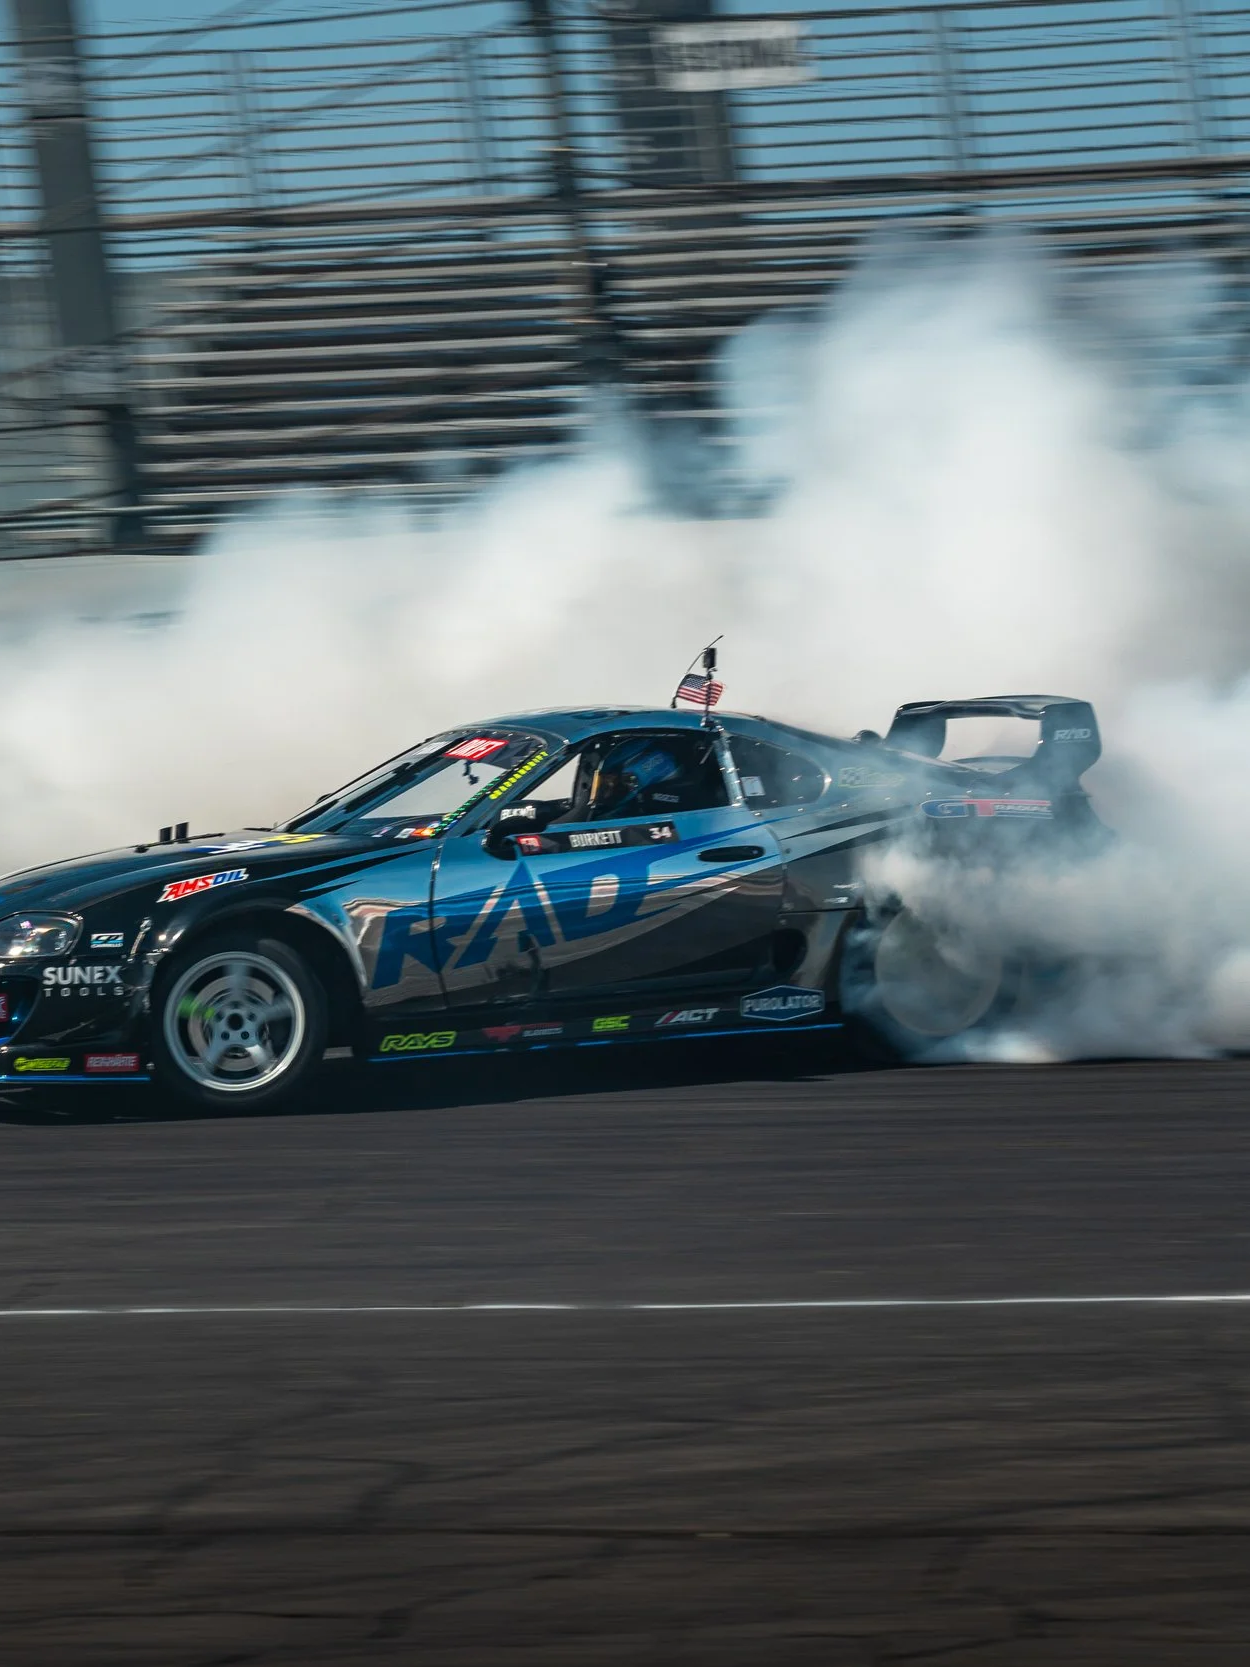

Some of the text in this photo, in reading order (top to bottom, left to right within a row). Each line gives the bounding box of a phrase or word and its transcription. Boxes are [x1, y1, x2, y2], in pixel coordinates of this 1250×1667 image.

[568, 830, 623, 848] BURKETT
[649, 826, 672, 840] 34
[161, 869, 246, 901] AMSOIL
[42, 966, 124, 985] SUNEX
[43, 986, 124, 997] TOOLS
[673, 1009, 720, 1025] ACT
[380, 1031, 456, 1051] RAYS
